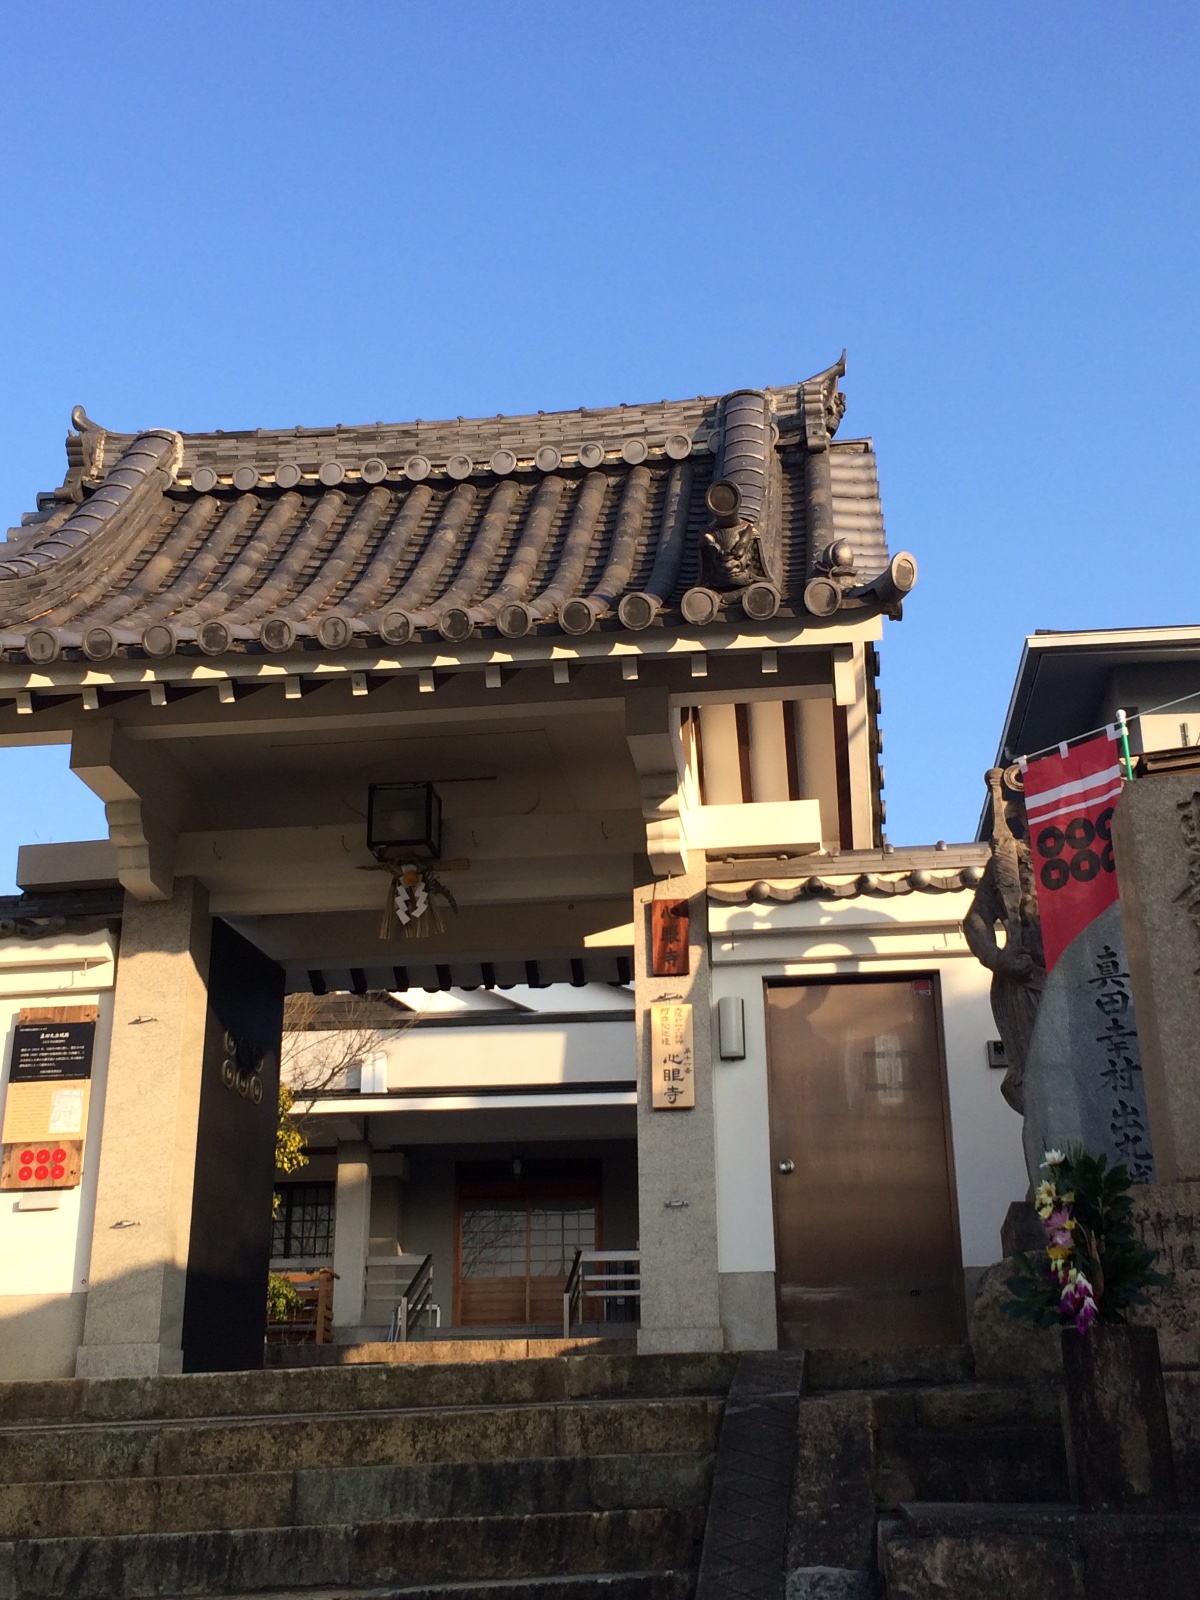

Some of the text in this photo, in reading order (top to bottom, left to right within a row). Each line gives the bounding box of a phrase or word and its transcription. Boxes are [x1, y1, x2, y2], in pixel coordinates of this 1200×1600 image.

[660, 905, 681, 968] 心眼寺
[663, 1053, 685, 1104] 心眼寺
